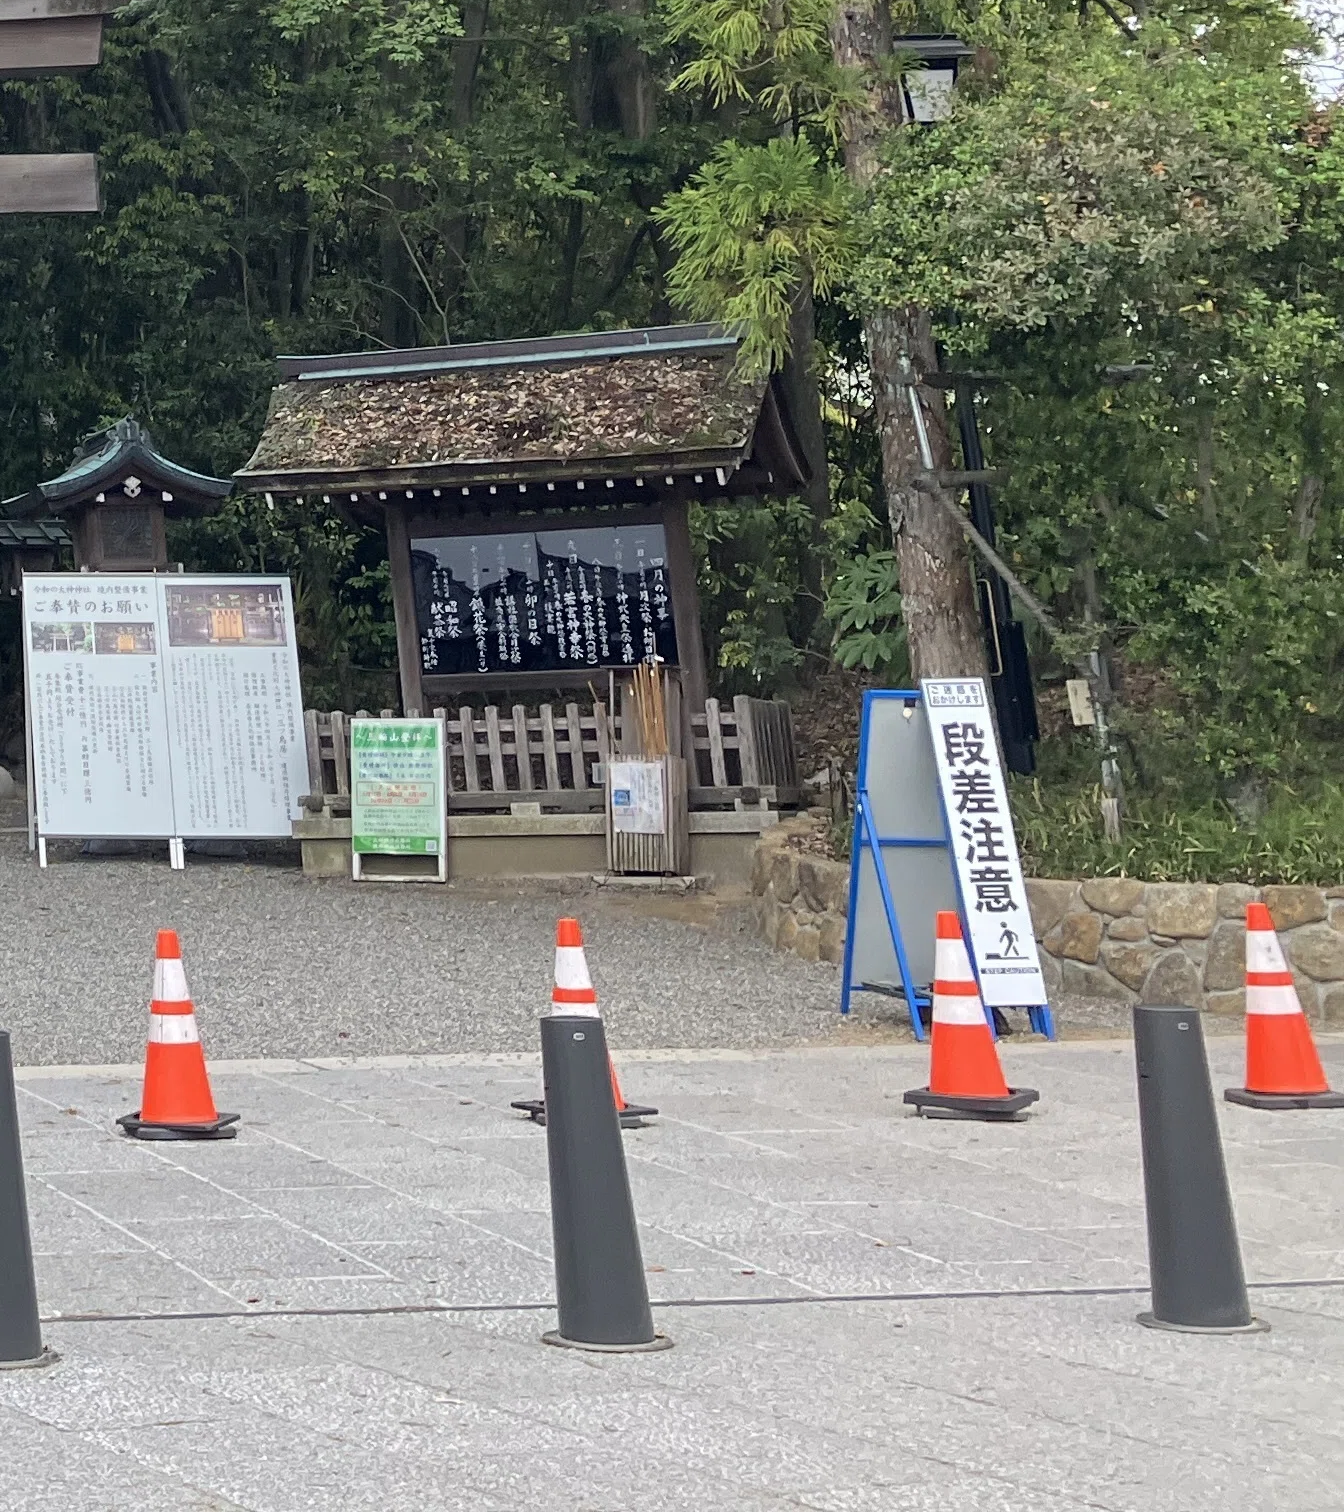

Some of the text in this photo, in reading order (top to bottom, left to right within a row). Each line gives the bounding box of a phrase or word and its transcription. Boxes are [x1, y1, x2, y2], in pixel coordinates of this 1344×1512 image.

[34, 599, 149, 615] ご奉賛のお願い
[444, 600, 463, 639] 昭和祭
[524, 593, 542, 646] 卯の日祭
[932, 695, 979, 704] おかけします
[941, 722, 1019, 913] 段差注意
